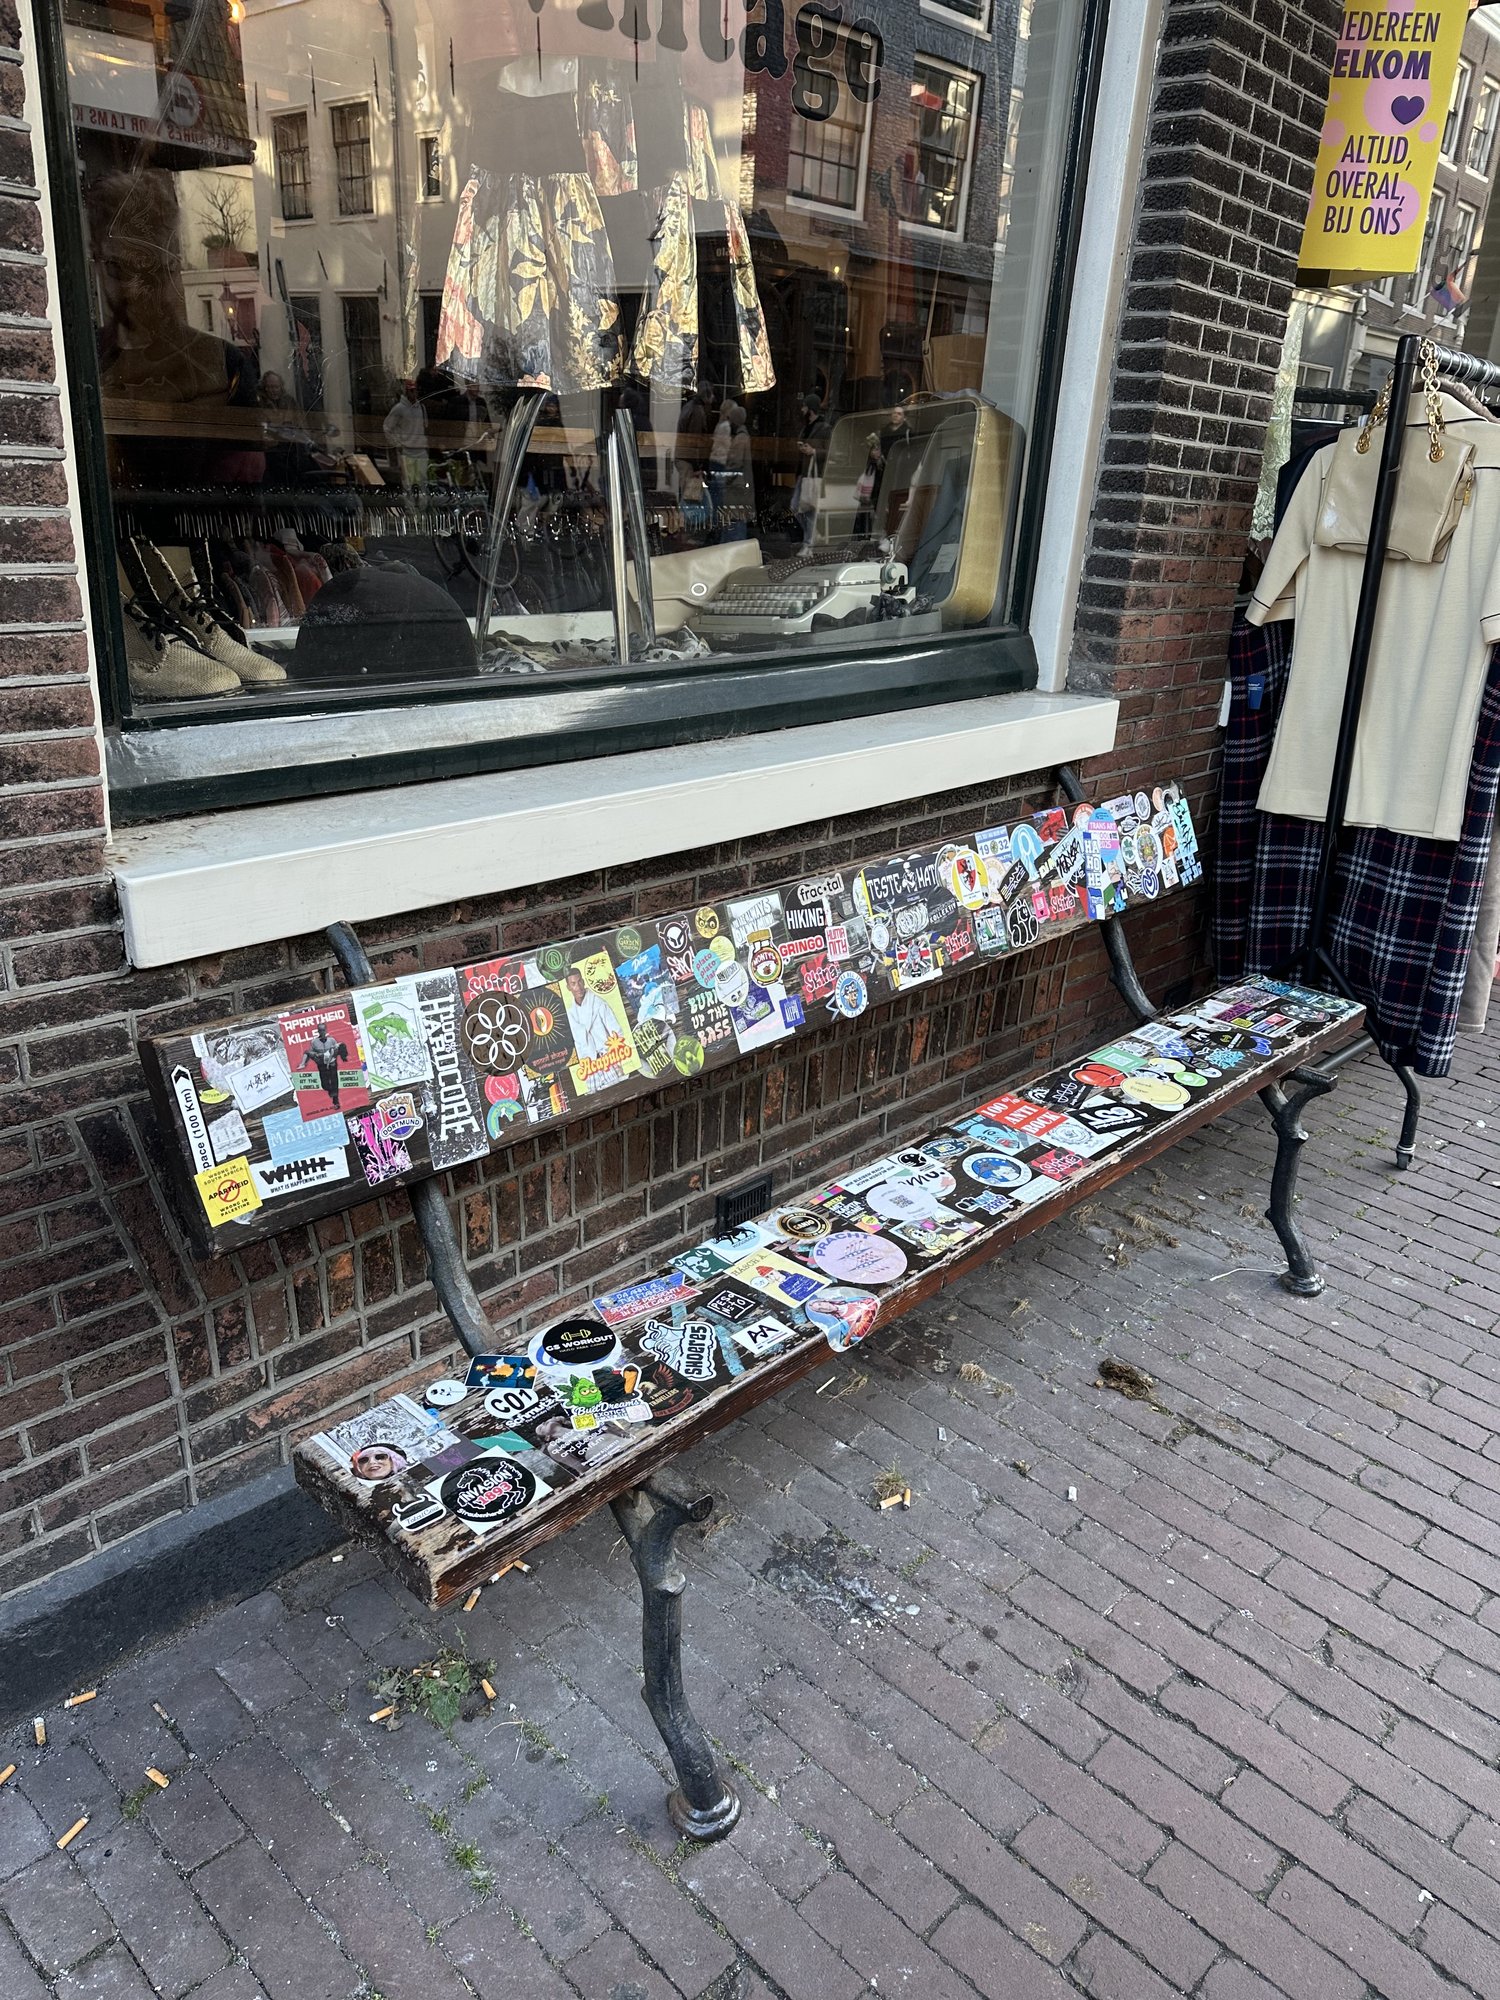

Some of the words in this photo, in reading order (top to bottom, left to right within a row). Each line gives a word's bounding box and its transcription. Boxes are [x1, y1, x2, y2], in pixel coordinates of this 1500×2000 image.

[1333, 49, 1432, 80] ELKOM
[1341, 135, 1413, 171] ALTIJD,
[1326, 170, 1405, 206] OVERAL,
[1323, 206, 1353, 233] BIJ
[1360, 206, 1403, 235] ONS
[867, 873, 902, 901] TESTE
[786, 907, 825, 930] HIKING
[780, 936, 823, 957] GRINGO
[700, 960, 717, 978] plato
[284, 1009, 346, 1032] APARTHEID
[691, 1013, 705, 1030] UP
[707, 1003, 729, 1022] THE
[287, 1029, 320, 1046] KILLS
[697, 1018, 732, 1048] BASS
[576, 1044, 633, 1081] Acapulco
[388, 1105, 407, 1118] GO
[981, 1103, 1009, 1118] 100
[1004, 1104, 1039, 1125] ANTI
[382, 1117, 421, 1136] DORTMUND
[203, 1175, 222, 1185] SOUTH
[223, 1167, 244, 1177] AFRICA
[208, 1168, 229, 1179] WRONG
[208, 1179, 249, 1201] APARTHEID
[220, 1201, 241, 1212] WRONG
[221, 1202, 250, 1217] PALESTINE
[816, 1231, 870, 1257] PRACHT
[545, 1343, 561, 1352] GS
[562, 1334, 614, 1348] WORKOUT
[459, 1469, 514, 1504] INVASION
[474, 1482, 513, 1506] 1893
